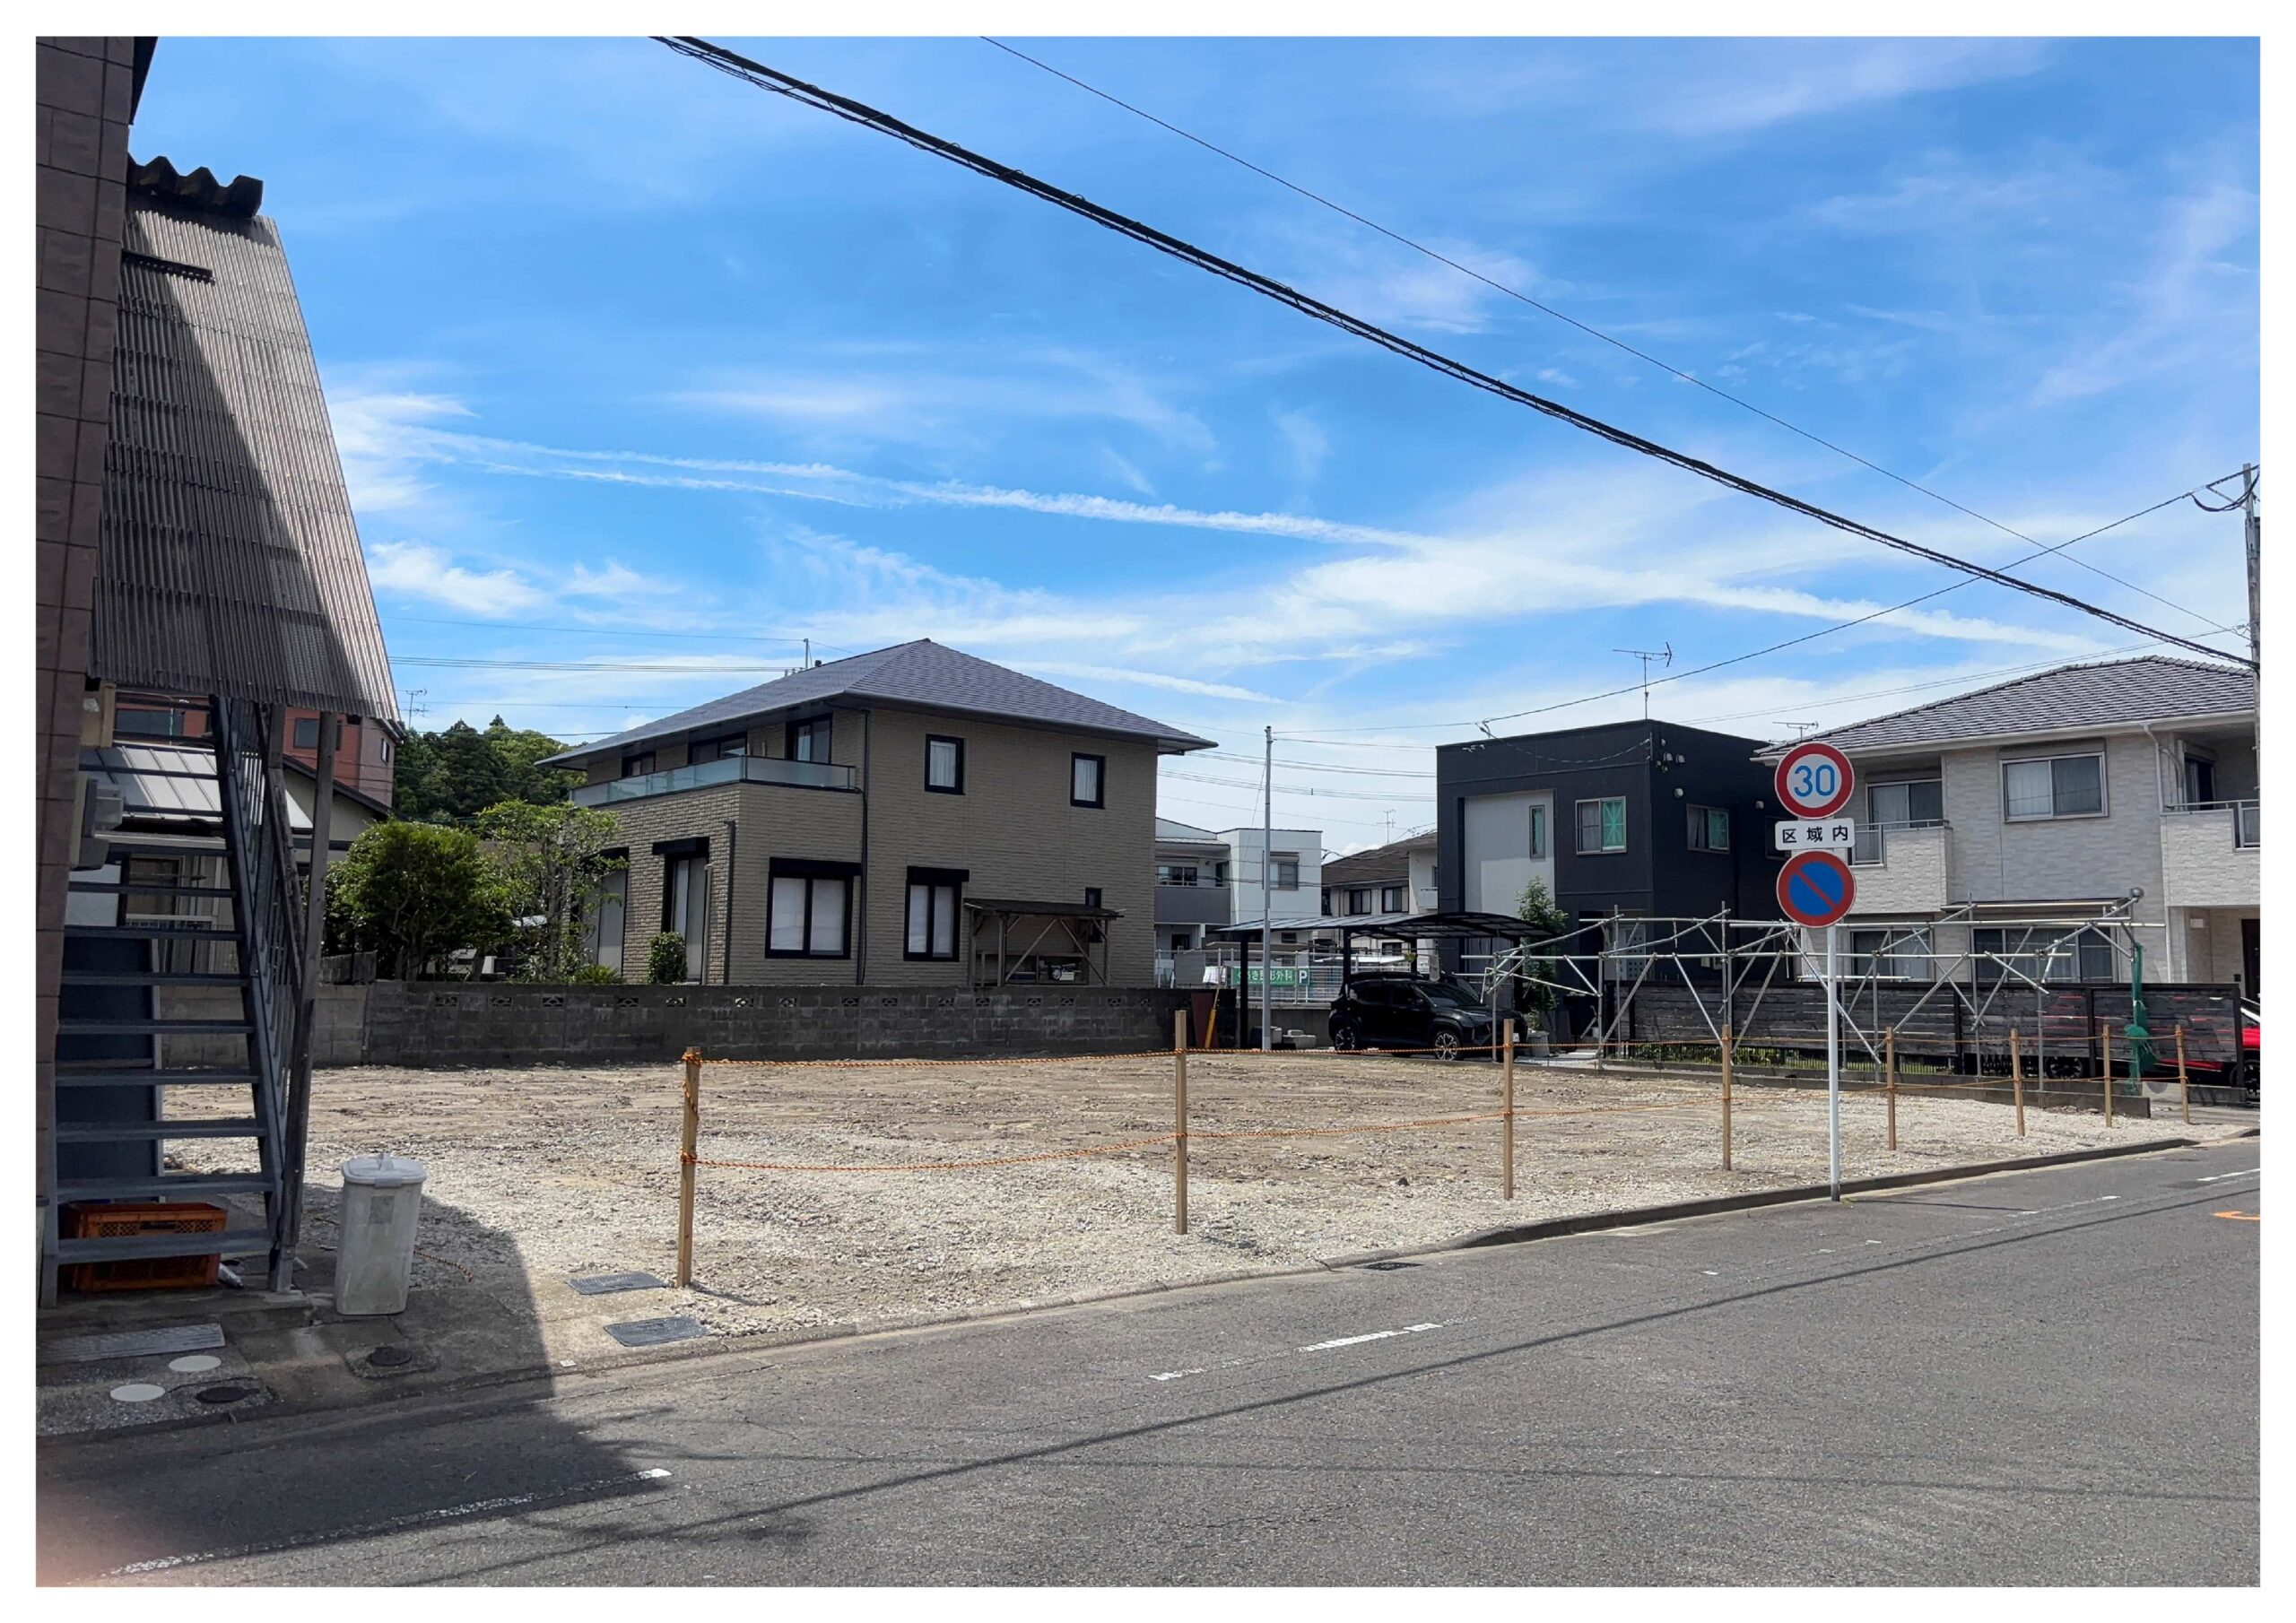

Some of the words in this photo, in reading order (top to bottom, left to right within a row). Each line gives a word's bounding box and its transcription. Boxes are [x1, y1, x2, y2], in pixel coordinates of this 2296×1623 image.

[1794, 764, 1835, 797] 30
[1782, 824, 1848, 844] 区域内
[1299, 969, 1309, 984] P
